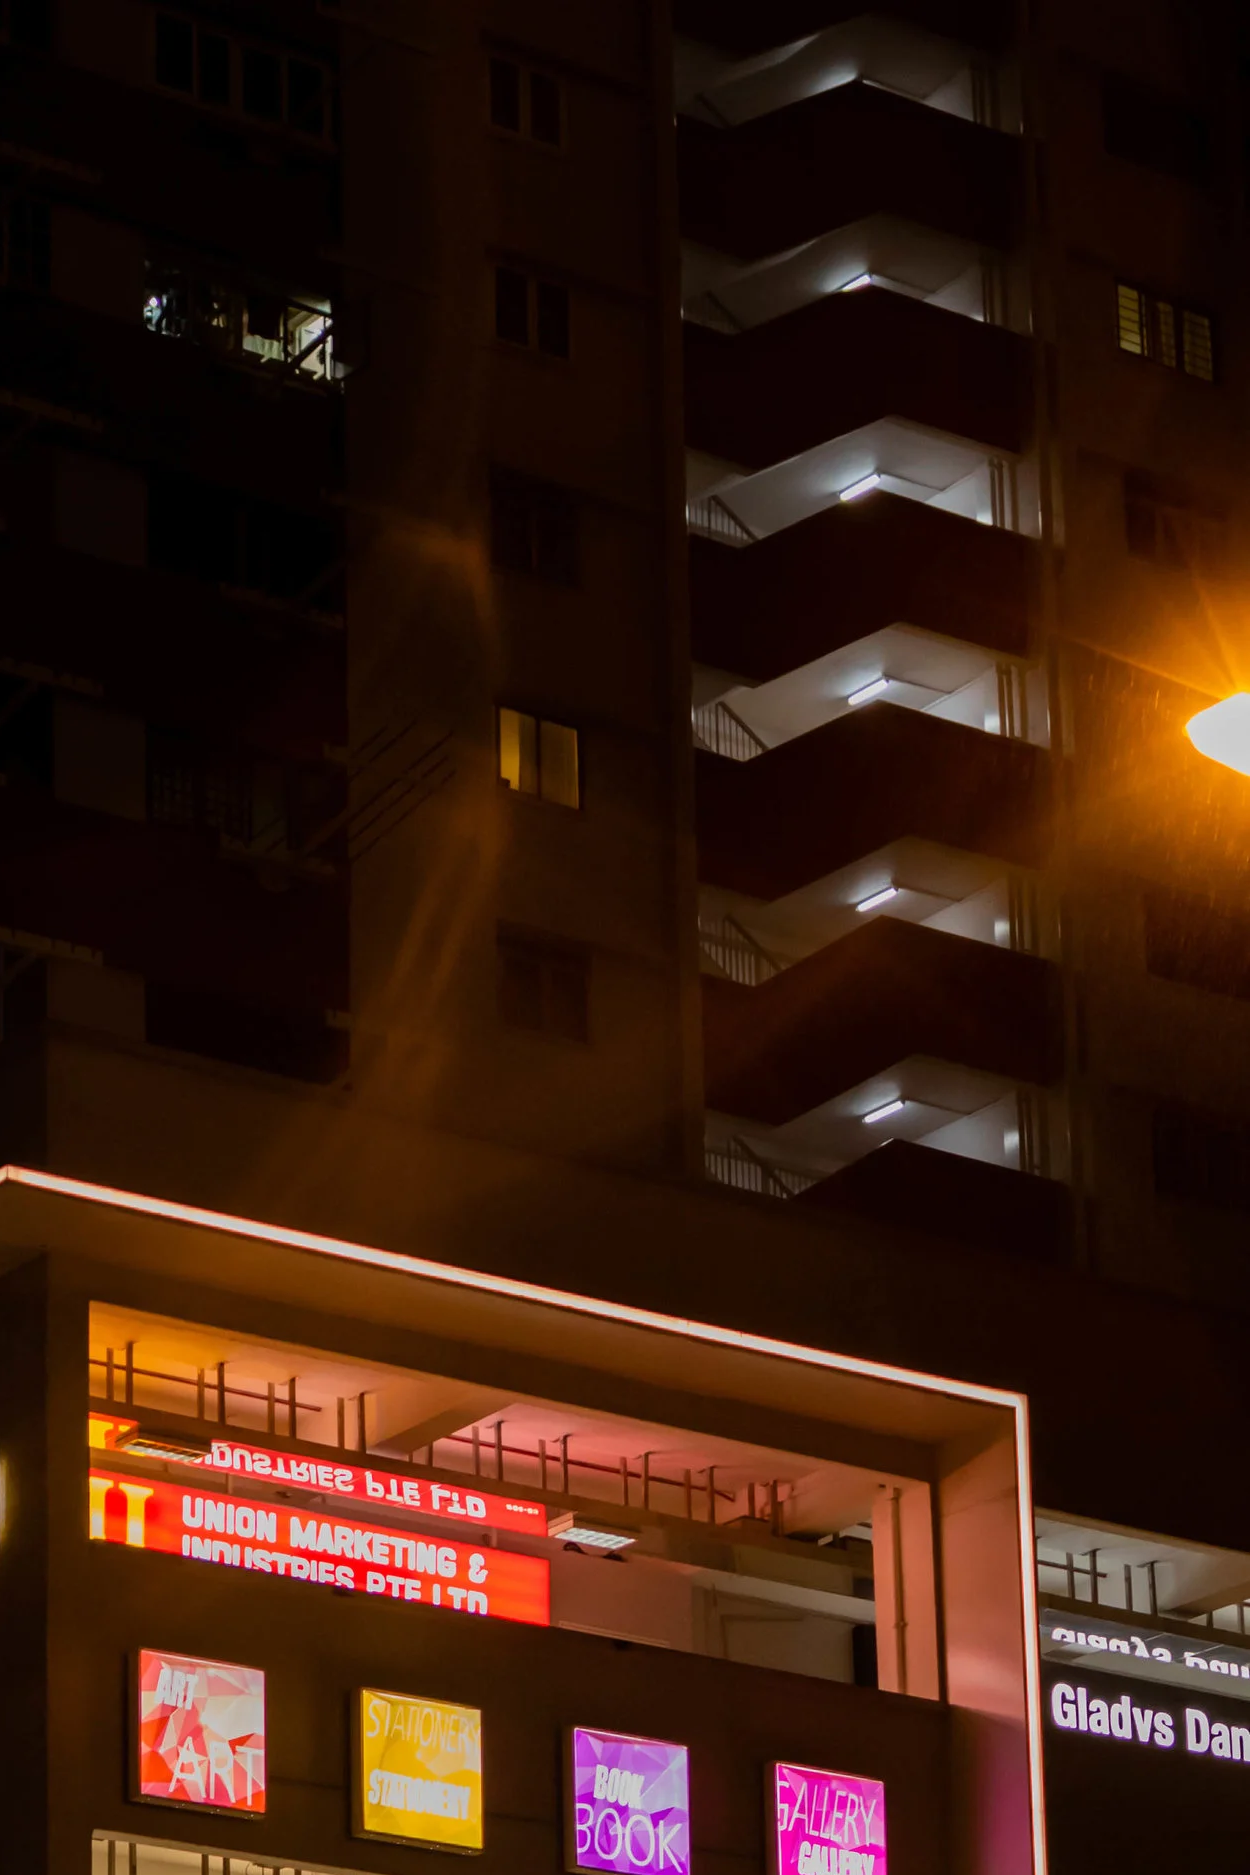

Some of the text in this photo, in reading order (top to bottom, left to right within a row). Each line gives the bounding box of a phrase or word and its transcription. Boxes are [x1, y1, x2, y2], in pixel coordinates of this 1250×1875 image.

[182, 1495, 277, 1544] UNION
[290, 1517, 457, 1578] MARKETING
[468, 1553, 488, 1584] &
[154, 1666, 199, 1711] ART
[366, 1699, 481, 1757] STATIONERY
[168, 1735, 264, 1807] ART
[368, 1768, 471, 1821] STATIONERY
[593, 1764, 646, 1810] BOOK
[576, 1802, 683, 1874] BOOK
[776, 1779, 878, 1848] GALLERY
